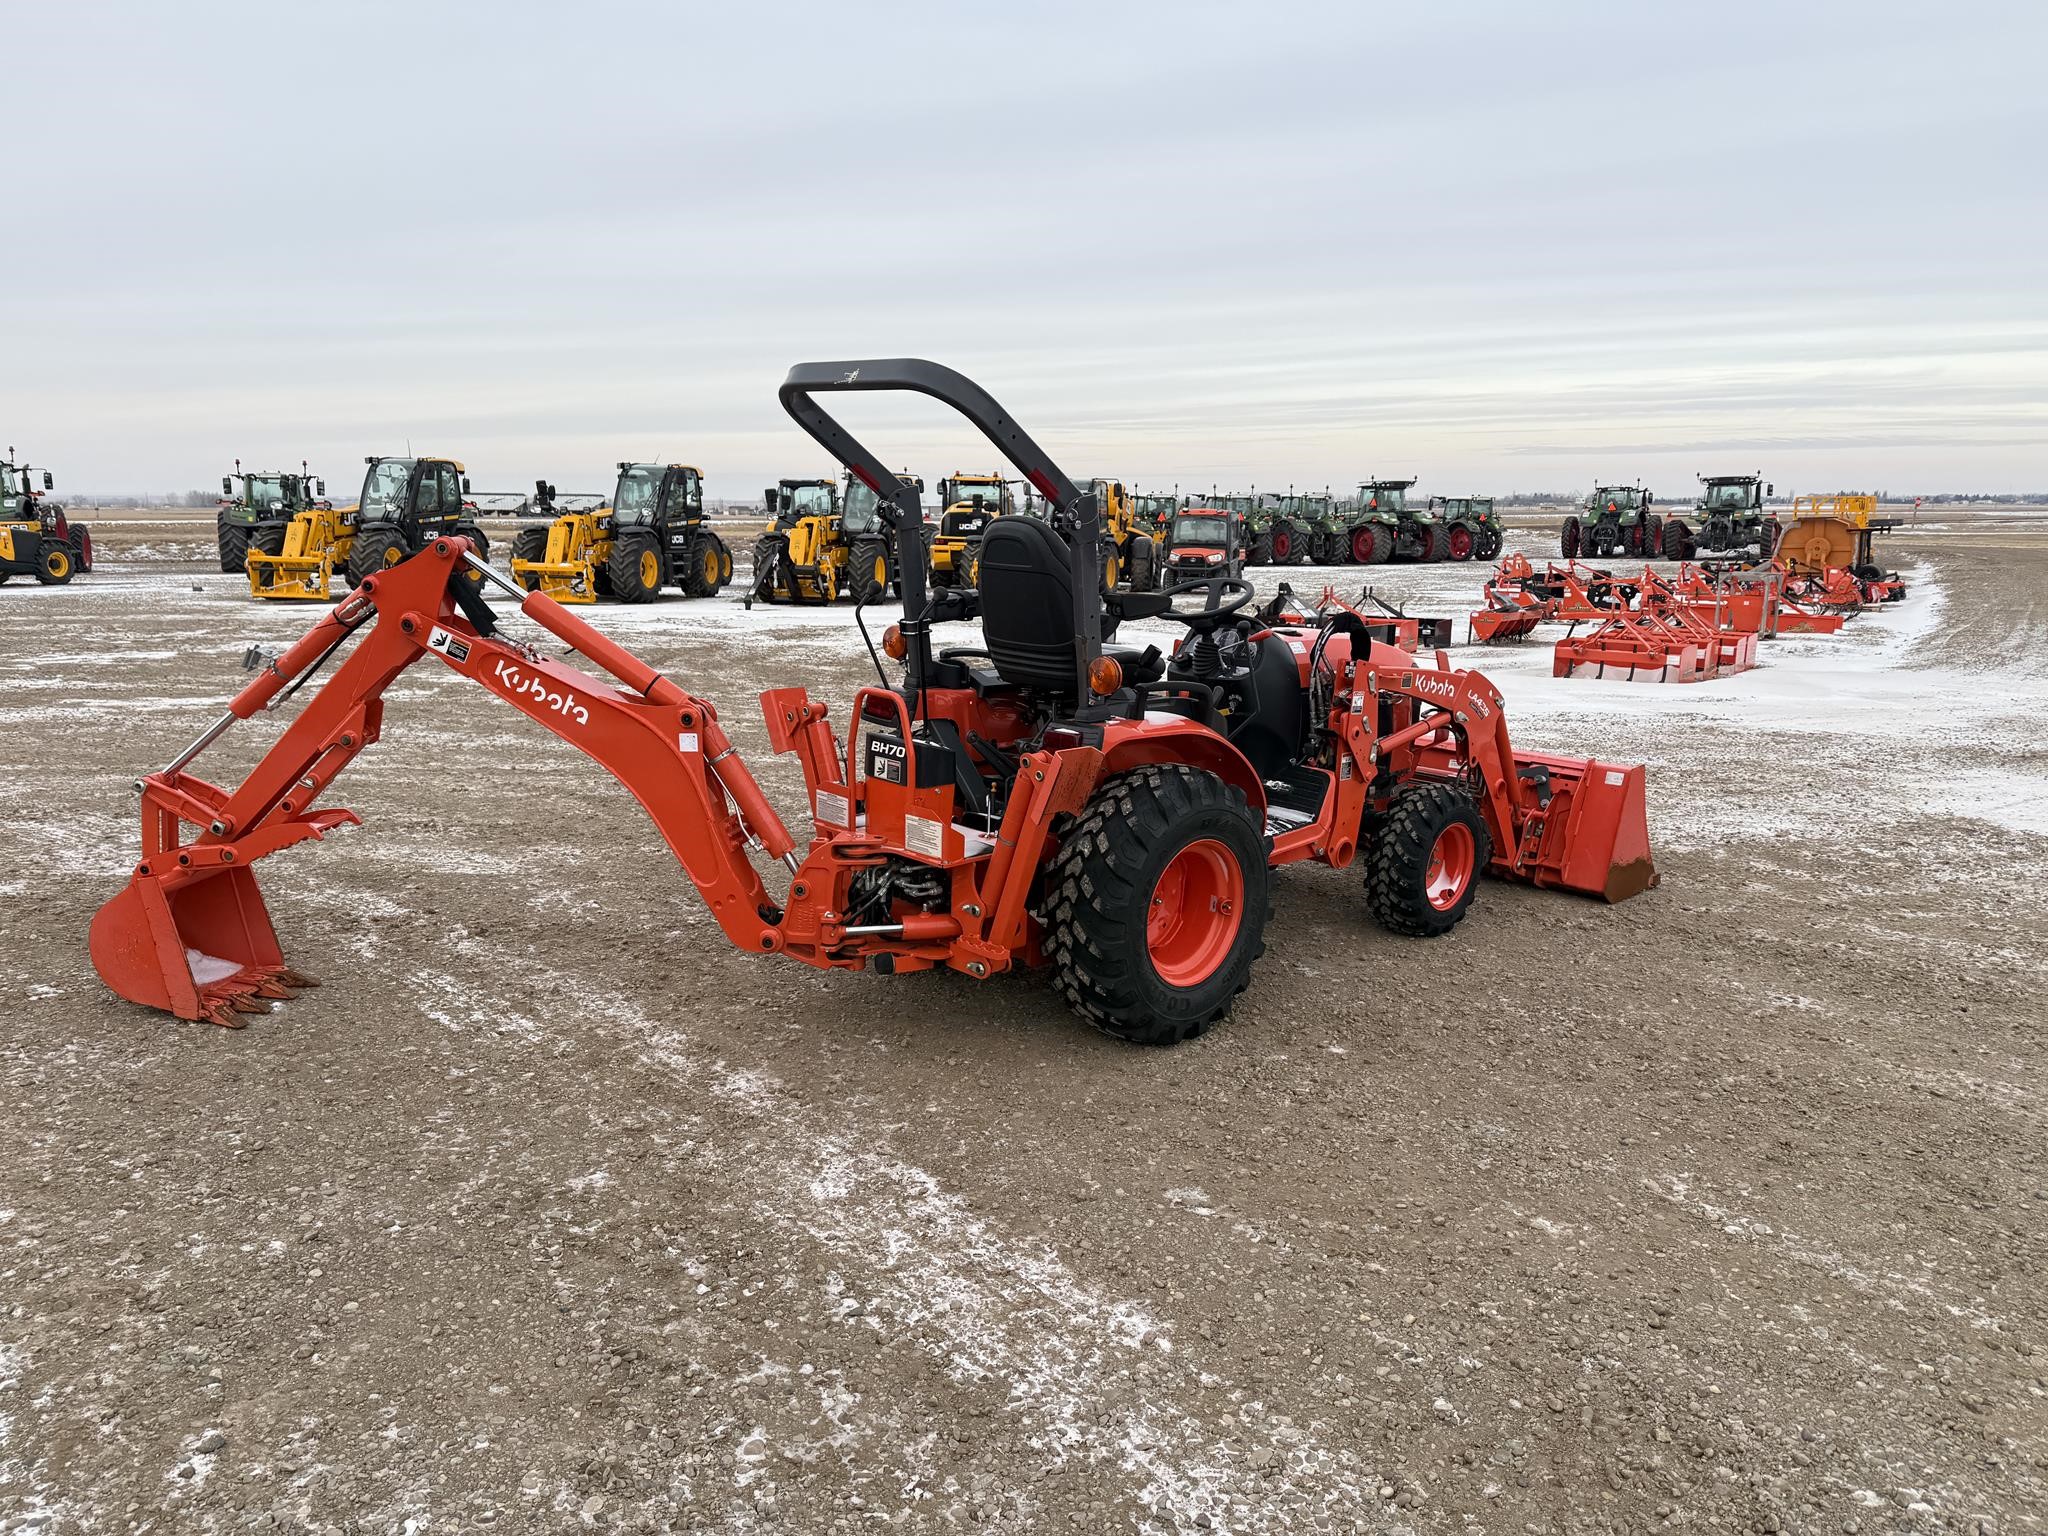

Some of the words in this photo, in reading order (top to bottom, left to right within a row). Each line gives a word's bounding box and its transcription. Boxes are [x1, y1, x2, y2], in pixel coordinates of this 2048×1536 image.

[423, 531, 439, 540] JCB
[671, 535, 684, 544] JCB
[494, 659, 590, 726] Kubota
[1415, 673, 1455, 697] Kubota
[1467, 689, 1490, 717] LA435
[871, 740, 906, 758] BH70
